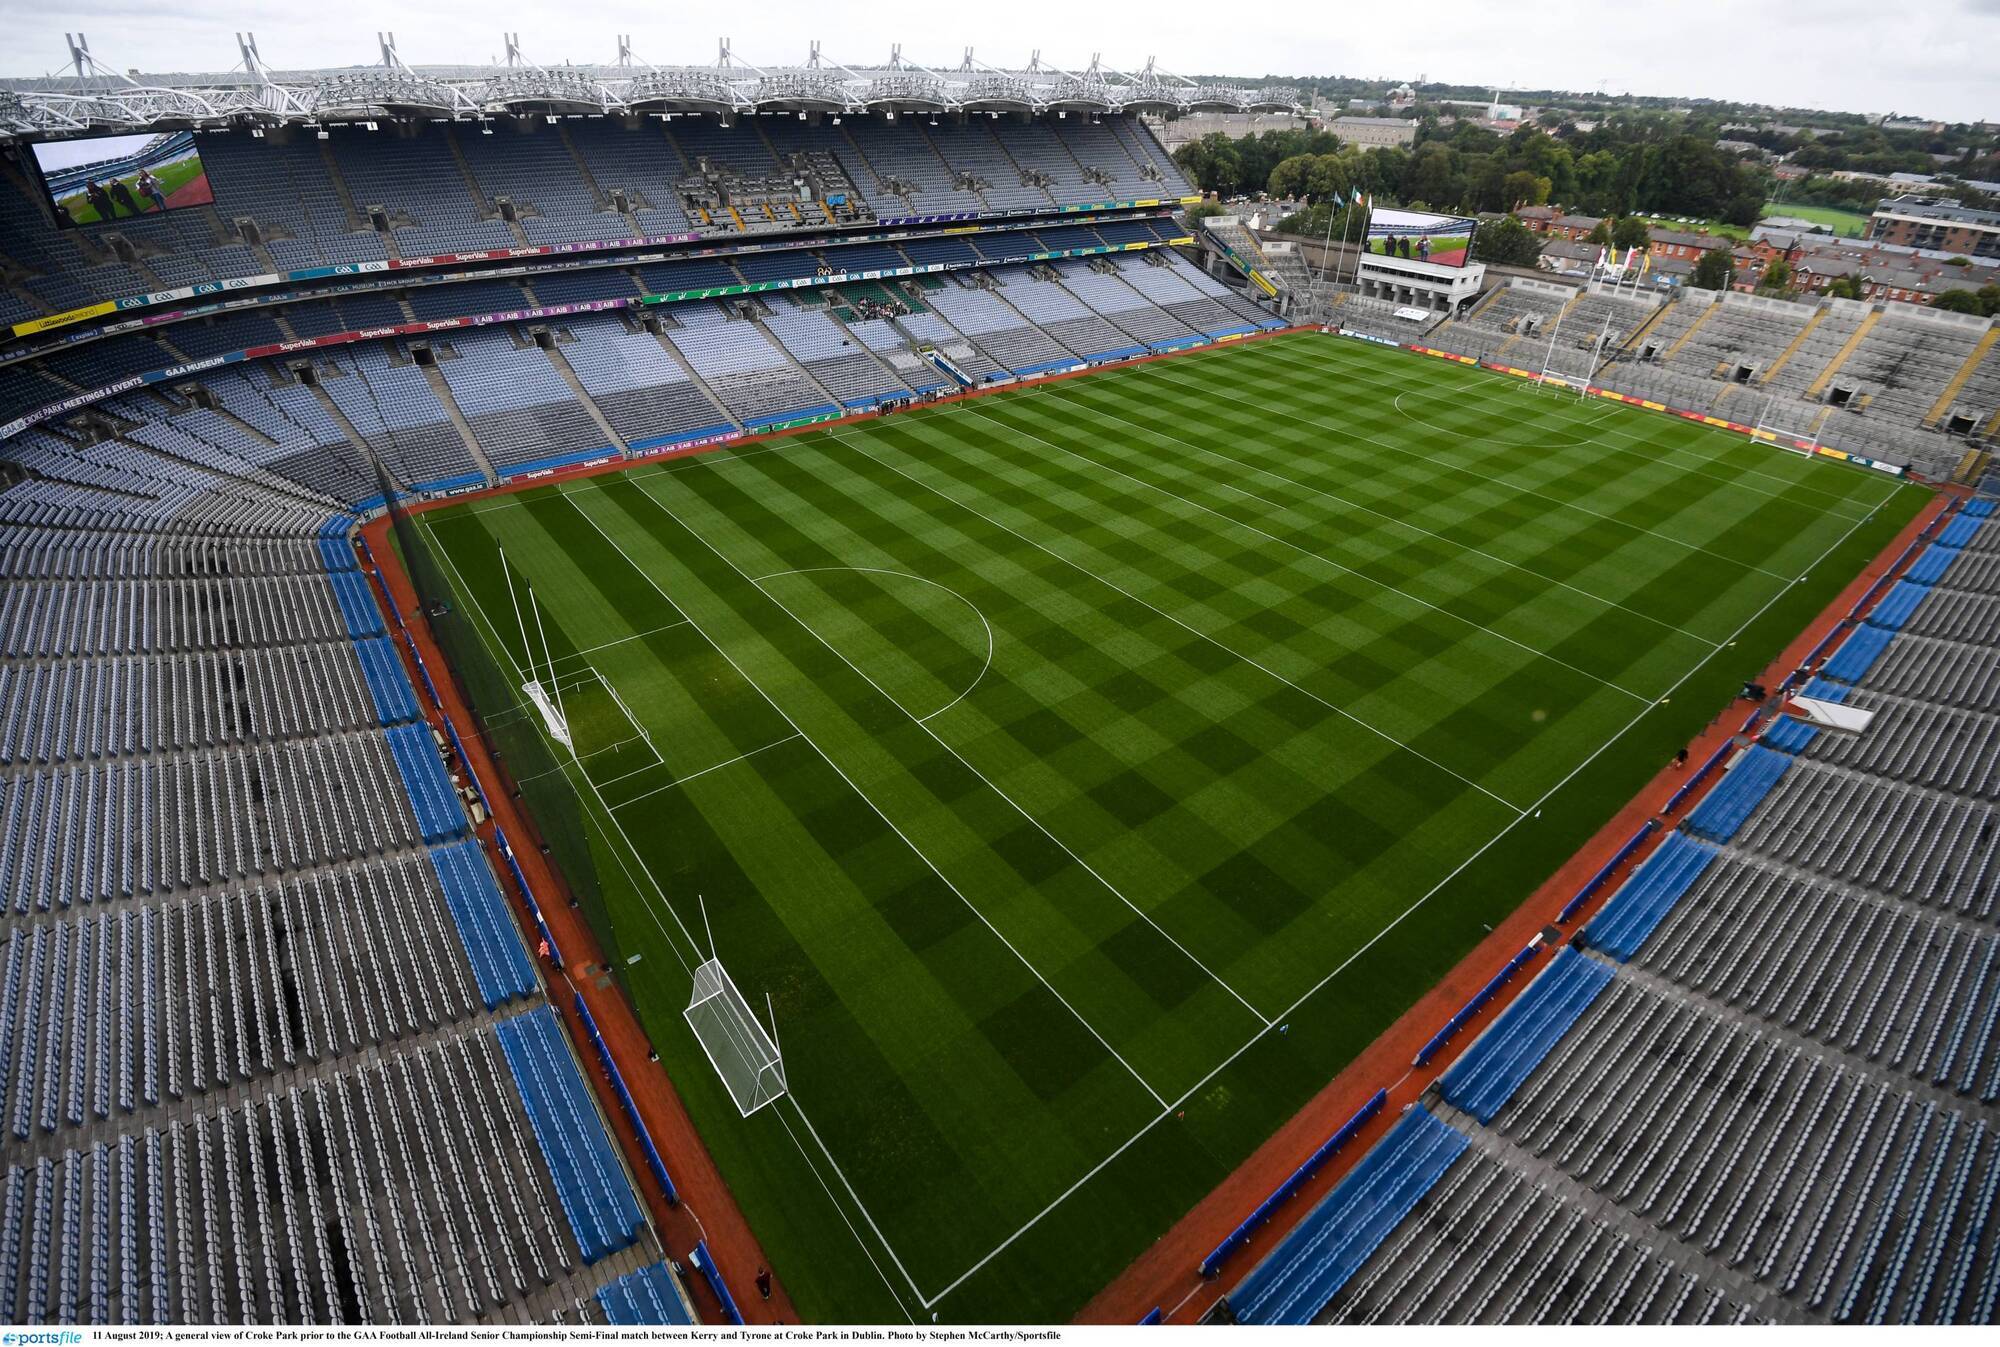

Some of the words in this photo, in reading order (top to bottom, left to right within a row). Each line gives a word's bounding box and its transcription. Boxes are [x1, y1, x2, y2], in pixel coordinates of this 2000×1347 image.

[455, 252, 489, 261] SuperValu
[508, 247, 541, 256] SuperValu
[399, 257, 434, 267] SuperValu
[427, 318, 460, 329] SuperValu
[359, 328, 395, 339] SuperValu
[279, 339, 317, 351] SuperValu
[165, 366, 187, 377] GAA
[187, 357, 225, 371] MUSEUM
[24, 411, 44, 426] CROKE
[43, 403, 64, 416] PARK
[63, 390, 106, 410] MEETINGS
[113, 377, 143, 392] EVENTS
[583, 457, 609, 468] SuperValu
[527, 468, 554, 479] SuperValu
[449, 483, 484, 495] www.gaa.ie
